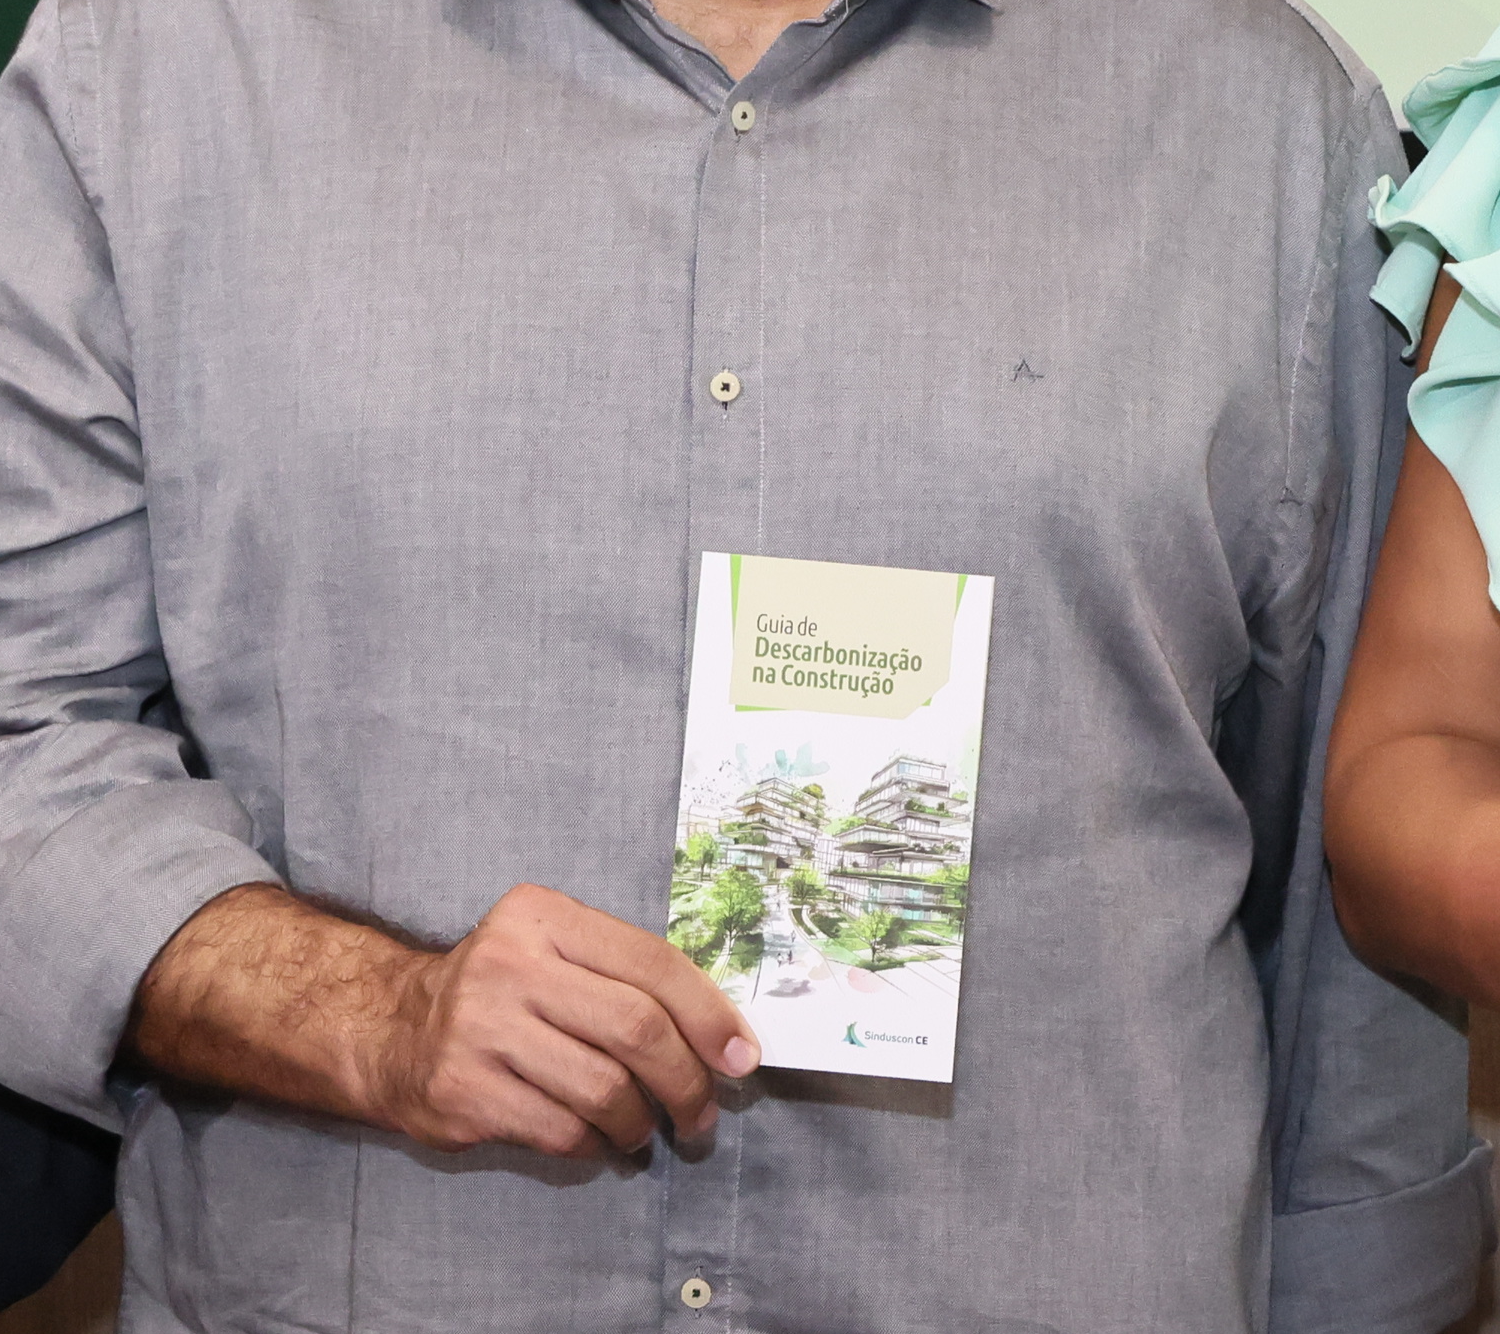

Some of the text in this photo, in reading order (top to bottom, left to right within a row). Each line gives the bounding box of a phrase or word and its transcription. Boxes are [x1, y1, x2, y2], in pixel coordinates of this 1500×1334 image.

[756, 613, 817, 637] Guia de
[754, 636, 922, 673] Descarbonização
[752, 665, 894, 698] na Construção
[864, 1030, 928, 1045] Sinduscon CE
